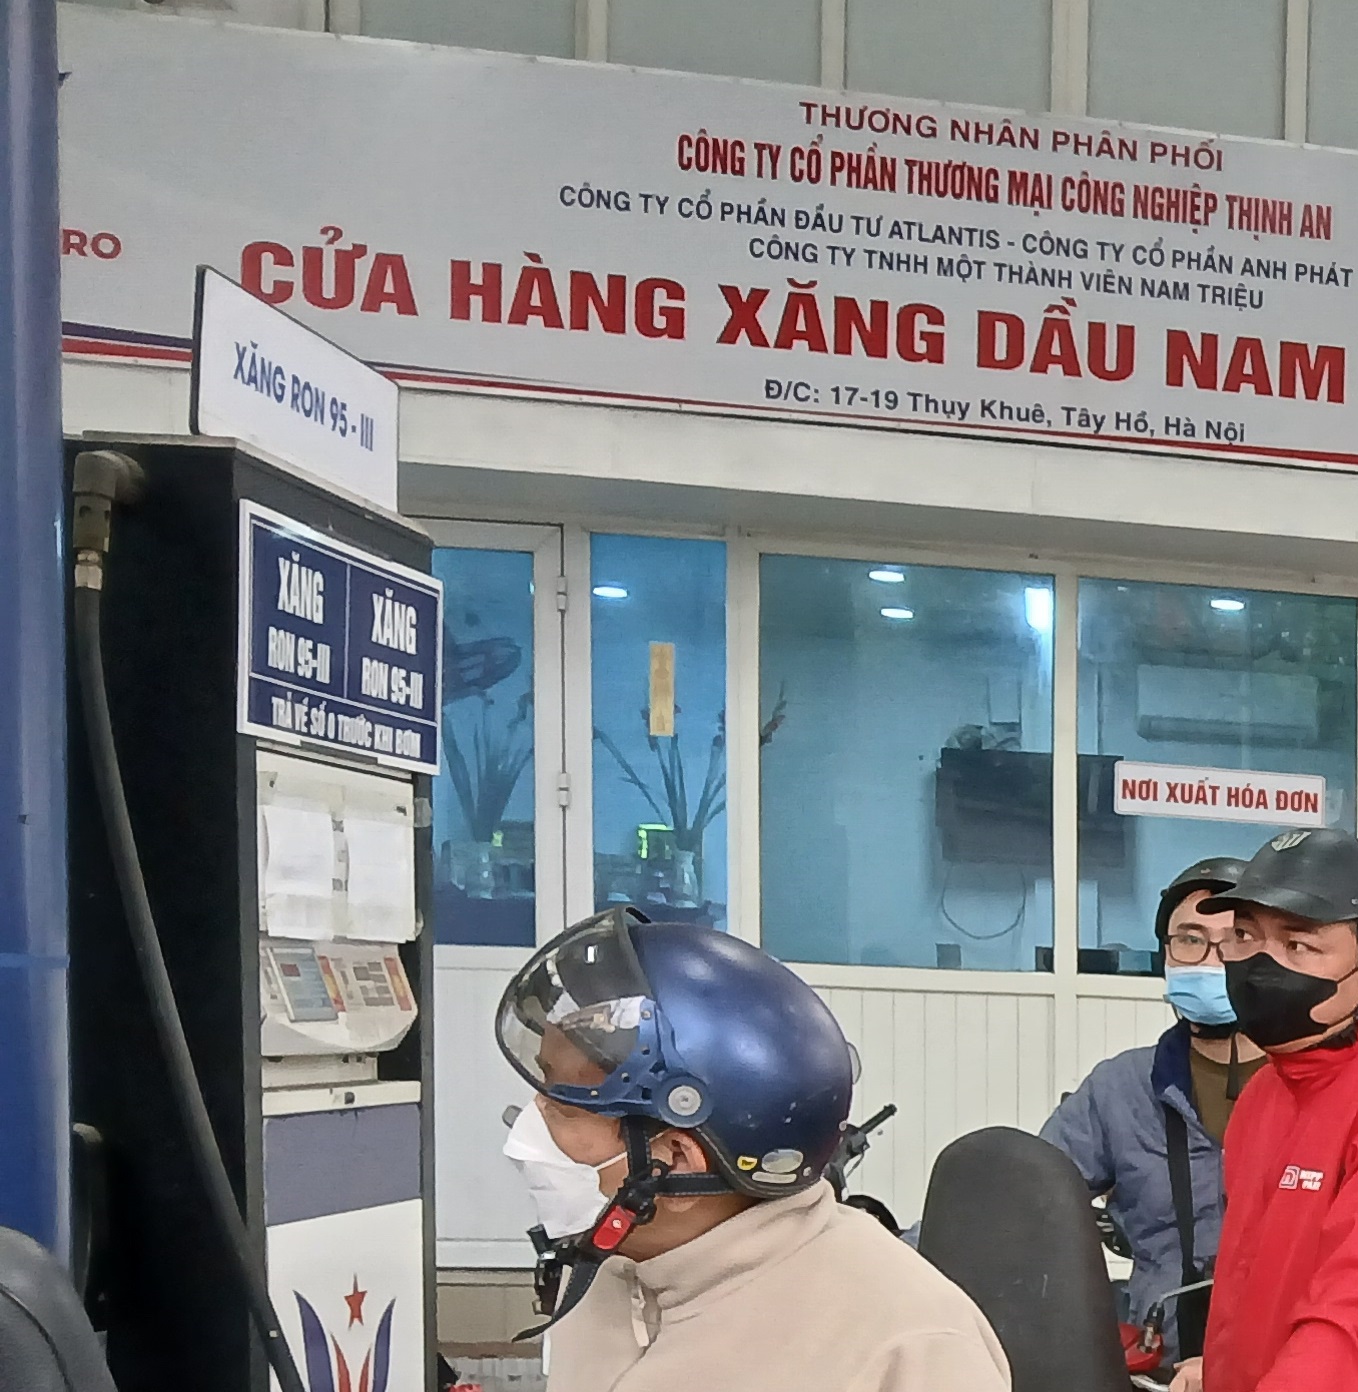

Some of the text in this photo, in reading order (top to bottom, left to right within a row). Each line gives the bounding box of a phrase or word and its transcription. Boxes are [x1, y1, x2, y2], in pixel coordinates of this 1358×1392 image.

[800, 102, 1223, 172] THƯƠNG NHÂN PHÂN PHỐI
[678, 129, 1333, 242] CÔNG TY CỔ PHẦN THƯƠNG MẠI CÔNG NGHIỆP THỊNH AN
[559, 185, 631, 213] CÔNG
[640, 194, 669, 216] TY
[678, 189, 713, 220] CỔ
[852, 211, 883, 238] TƯ
[889, 217, 1000, 250] ATLANTIS
[1022, 230, 1088, 262] CÔNG
[1097, 242, 1125, 264] TY
[1132, 236, 1164, 268] CỔ
[1241, 256, 1288, 281] ANH
[1295, 255, 1353, 288] PHÁT
[749, 235, 1264, 310] CÔNG TY TNHH MỘT THÀNH VIÊN NAM TRIỆU
[240, 225, 419, 317] CỬA
[450, 250, 688, 341] HÀNG
[717, 276, 945, 365] XĂNG
[976, 297, 1136, 383] DẦU
[1165, 331, 1345, 404] NAM
[234, 340, 286, 403] XĂNG
[290, 374, 325, 425] RON
[330, 397, 347, 437] 95
[764, 379, 1246, 446] Đ/C: 17-19 Thụy Khuê, Tây Hồ, Hà Nội
[277, 551, 324, 625] XĂNG
[371, 588, 417, 655] XĂNG
[267, 626, 295, 668] RON
[361, 657, 389, 701] RON
[1121, 777, 1318, 813] NƠI XUẤT HÓA ĐƠN
